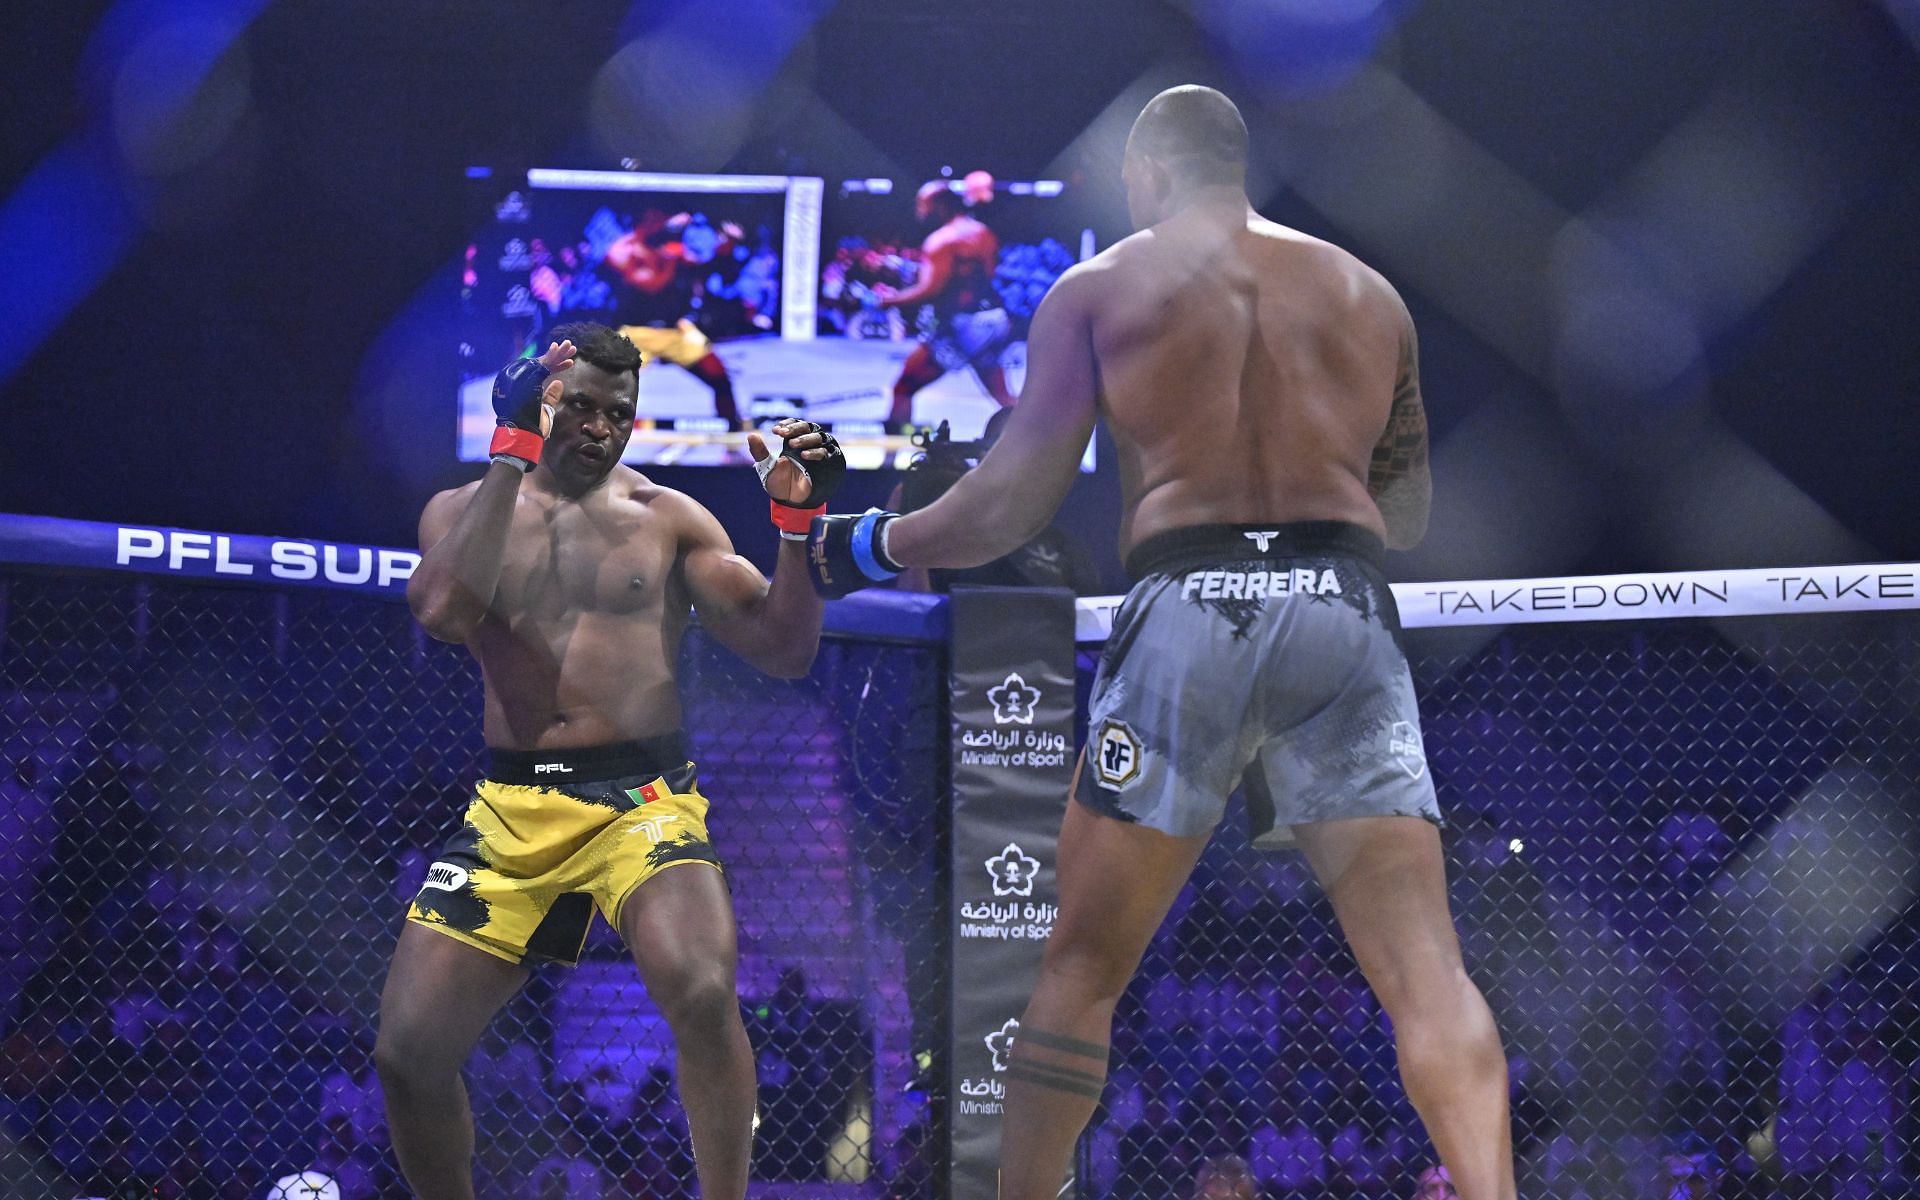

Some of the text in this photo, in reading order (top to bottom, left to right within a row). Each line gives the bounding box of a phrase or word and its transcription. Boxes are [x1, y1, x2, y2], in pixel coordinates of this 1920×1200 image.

[116, 527, 253, 575] PFL
[1181, 568, 1342, 600] FERREIRA
[1424, 580, 1728, 615] TAKEDOWN
[1766, 573, 1915, 602] TAKE
[962, 729, 1065, 751] وزارة الرياضة
[534, 763, 573, 774] PFL
[961, 751, 1065, 768] Ministry of Sport
[960, 902, 1019, 924] الرياضة
[960, 923, 1009, 940] Ministry
[1010, 924, 1025, 938] of
